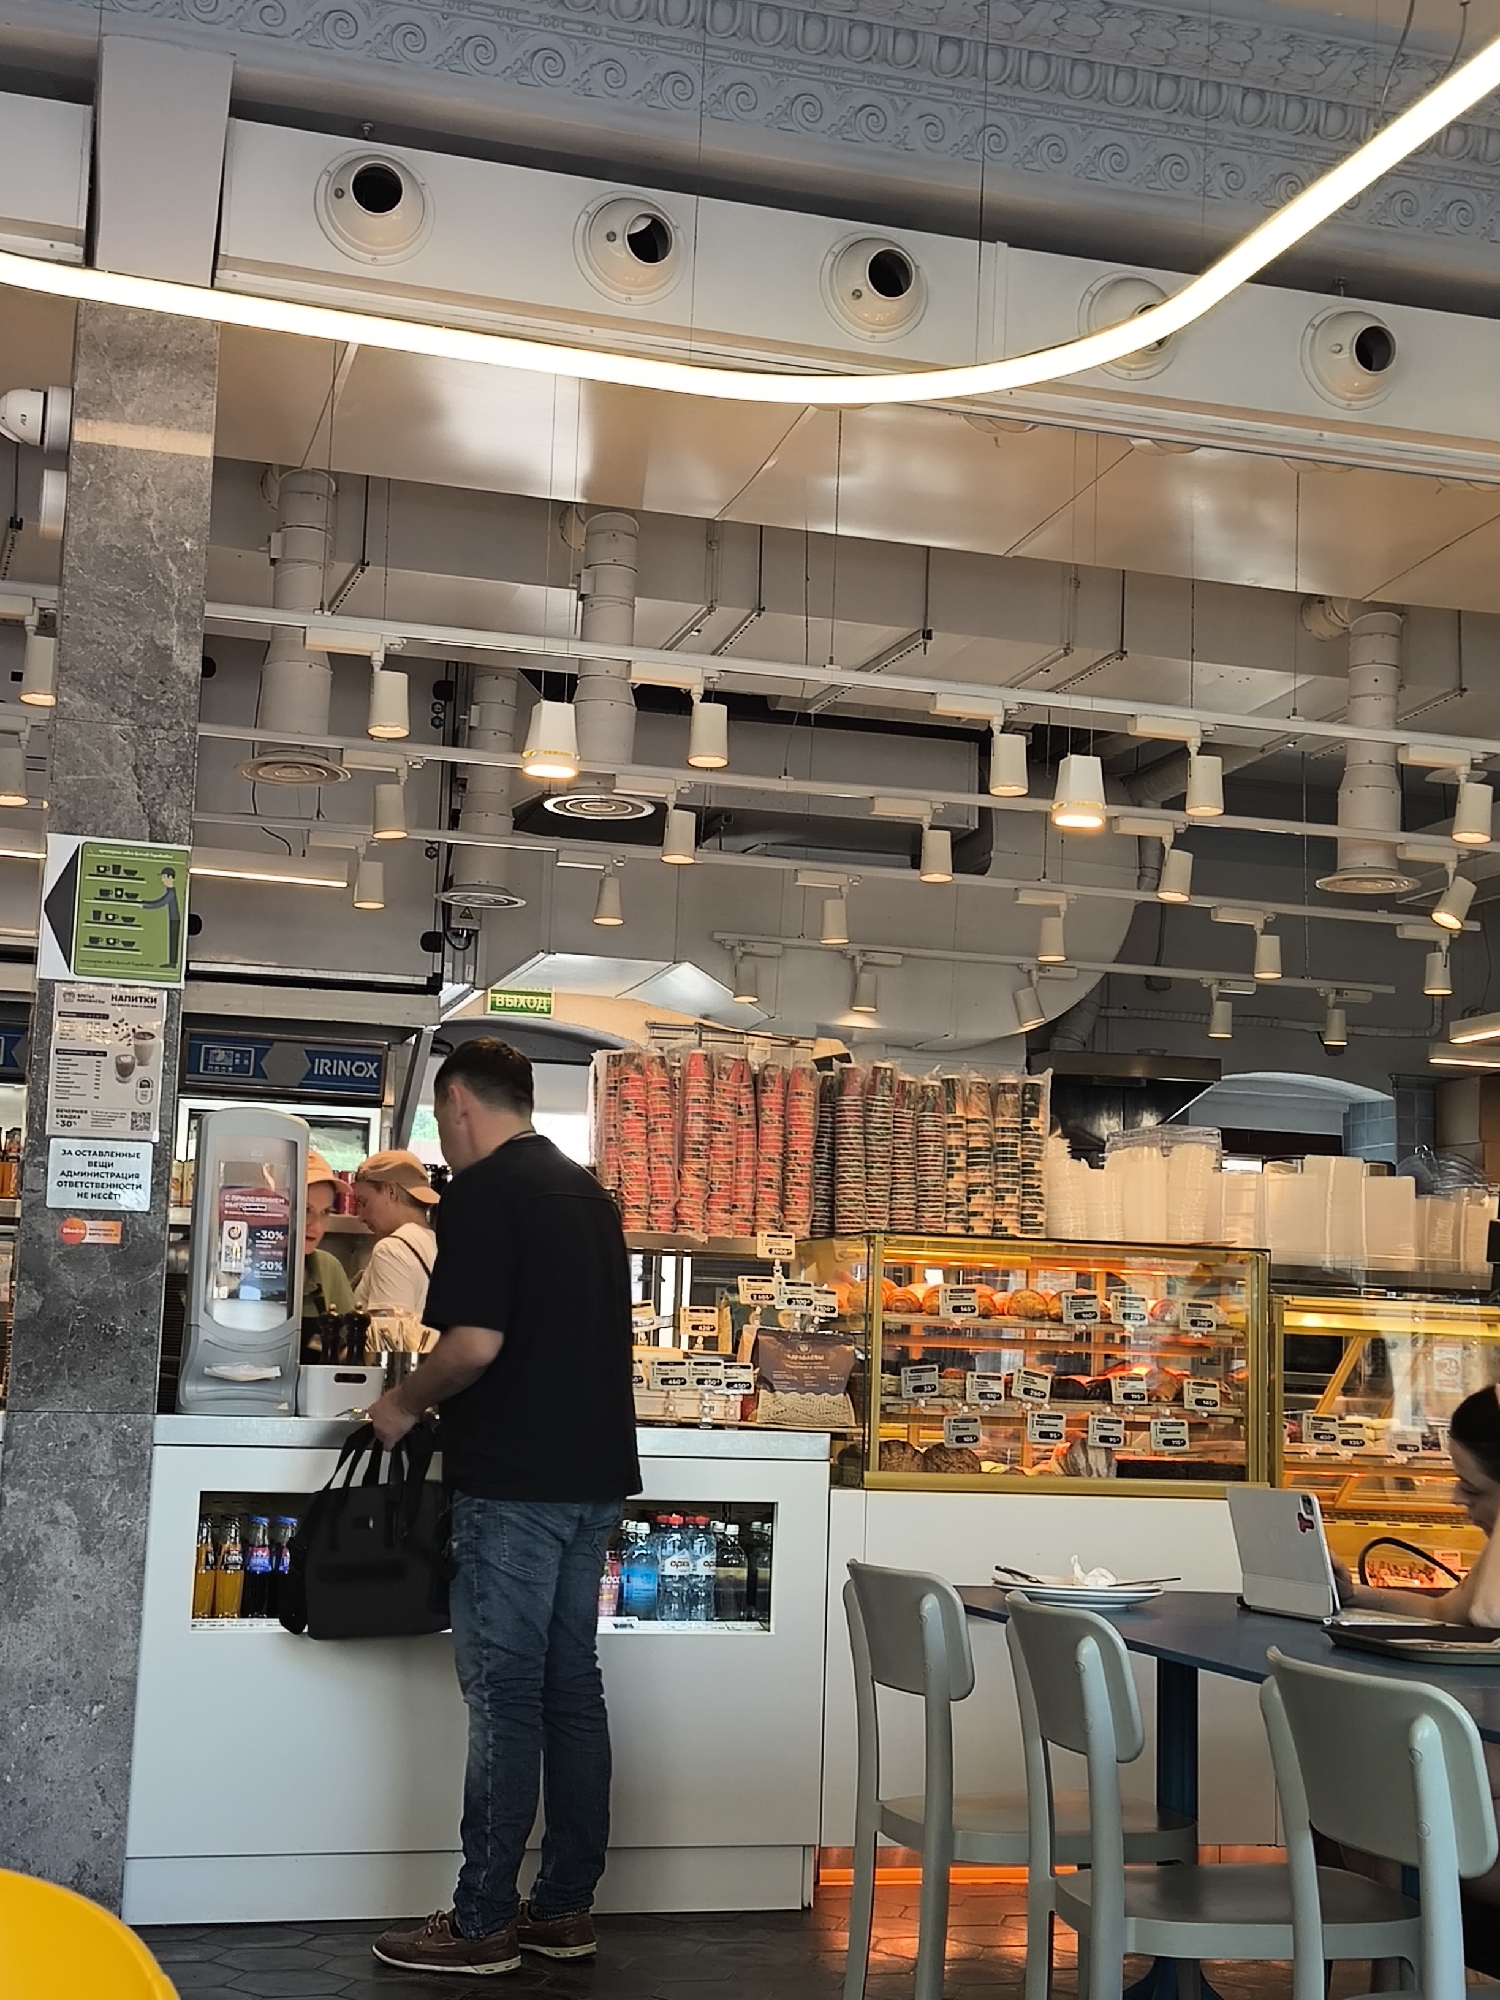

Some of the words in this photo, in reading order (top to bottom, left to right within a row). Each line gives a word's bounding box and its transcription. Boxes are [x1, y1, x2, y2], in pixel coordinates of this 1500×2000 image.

[111, 994, 157, 1004] НАПИТКИ
[495, 995, 548, 1012] ВЫХОД
[314, 1057, 378, 1079] IRINOX
[75, 1149, 141, 1159] ОСТАВЛЕННЫЕ
[88, 1161, 114, 1169] ВЕЩИ
[60, 1170, 140, 1180] АДМИНИСТРАЦИЯ
[57, 1181, 142, 1190] ОТВЕТСТВЕННОСТИ
[256, 1230, 285, 1241] -30%
[256, 1261, 283, 1271] -20%
